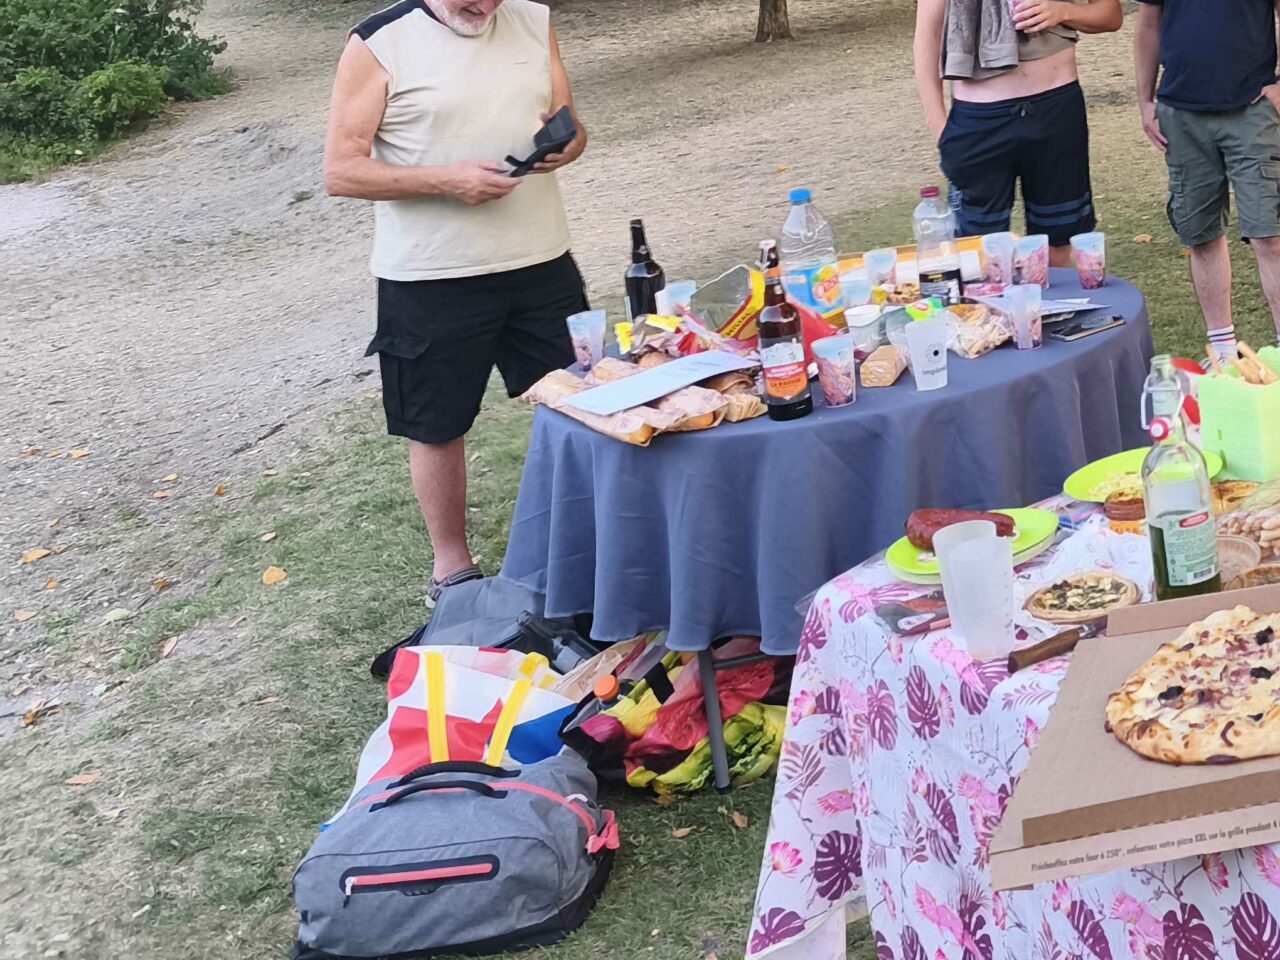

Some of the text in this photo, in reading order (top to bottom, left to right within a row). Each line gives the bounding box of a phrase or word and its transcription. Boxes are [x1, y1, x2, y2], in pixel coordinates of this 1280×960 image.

[1069, 855, 1085, 865] votre
[1086, 852, 1099, 863] four
[1159, 839, 1175, 849] votre
[1177, 837, 1193, 848] pizza
[1208, 832, 1218, 840] sur
[1219, 829, 1226, 838] la
[1228, 825, 1244, 839] grille
[1245, 822, 1271, 835] pendant
